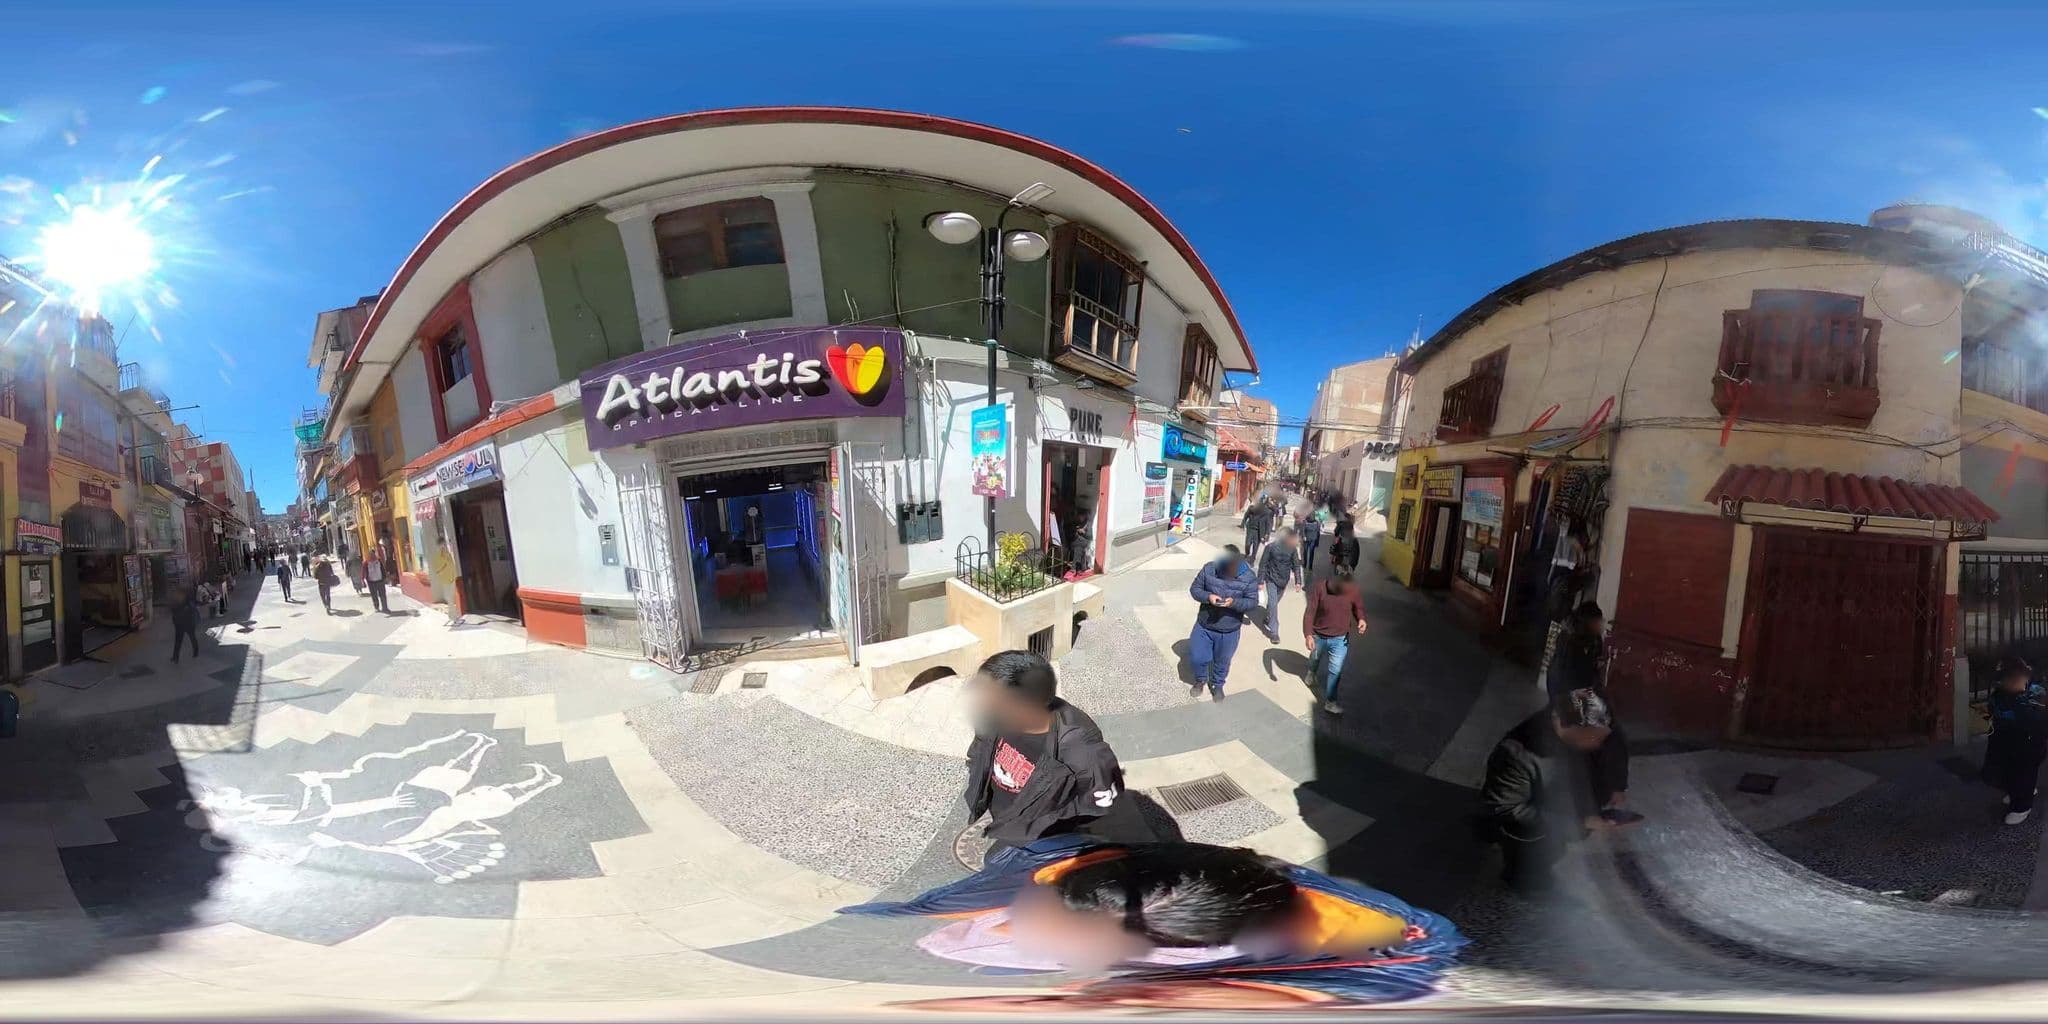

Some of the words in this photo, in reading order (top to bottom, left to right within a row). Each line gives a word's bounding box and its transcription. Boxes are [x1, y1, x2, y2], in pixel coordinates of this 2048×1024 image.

[595, 352, 821, 420] Atlantis
[738, 394, 804, 409] LINE
[1070, 407, 1103, 438] PURE
[1184, 477, 1197, 533] OPTICAS
